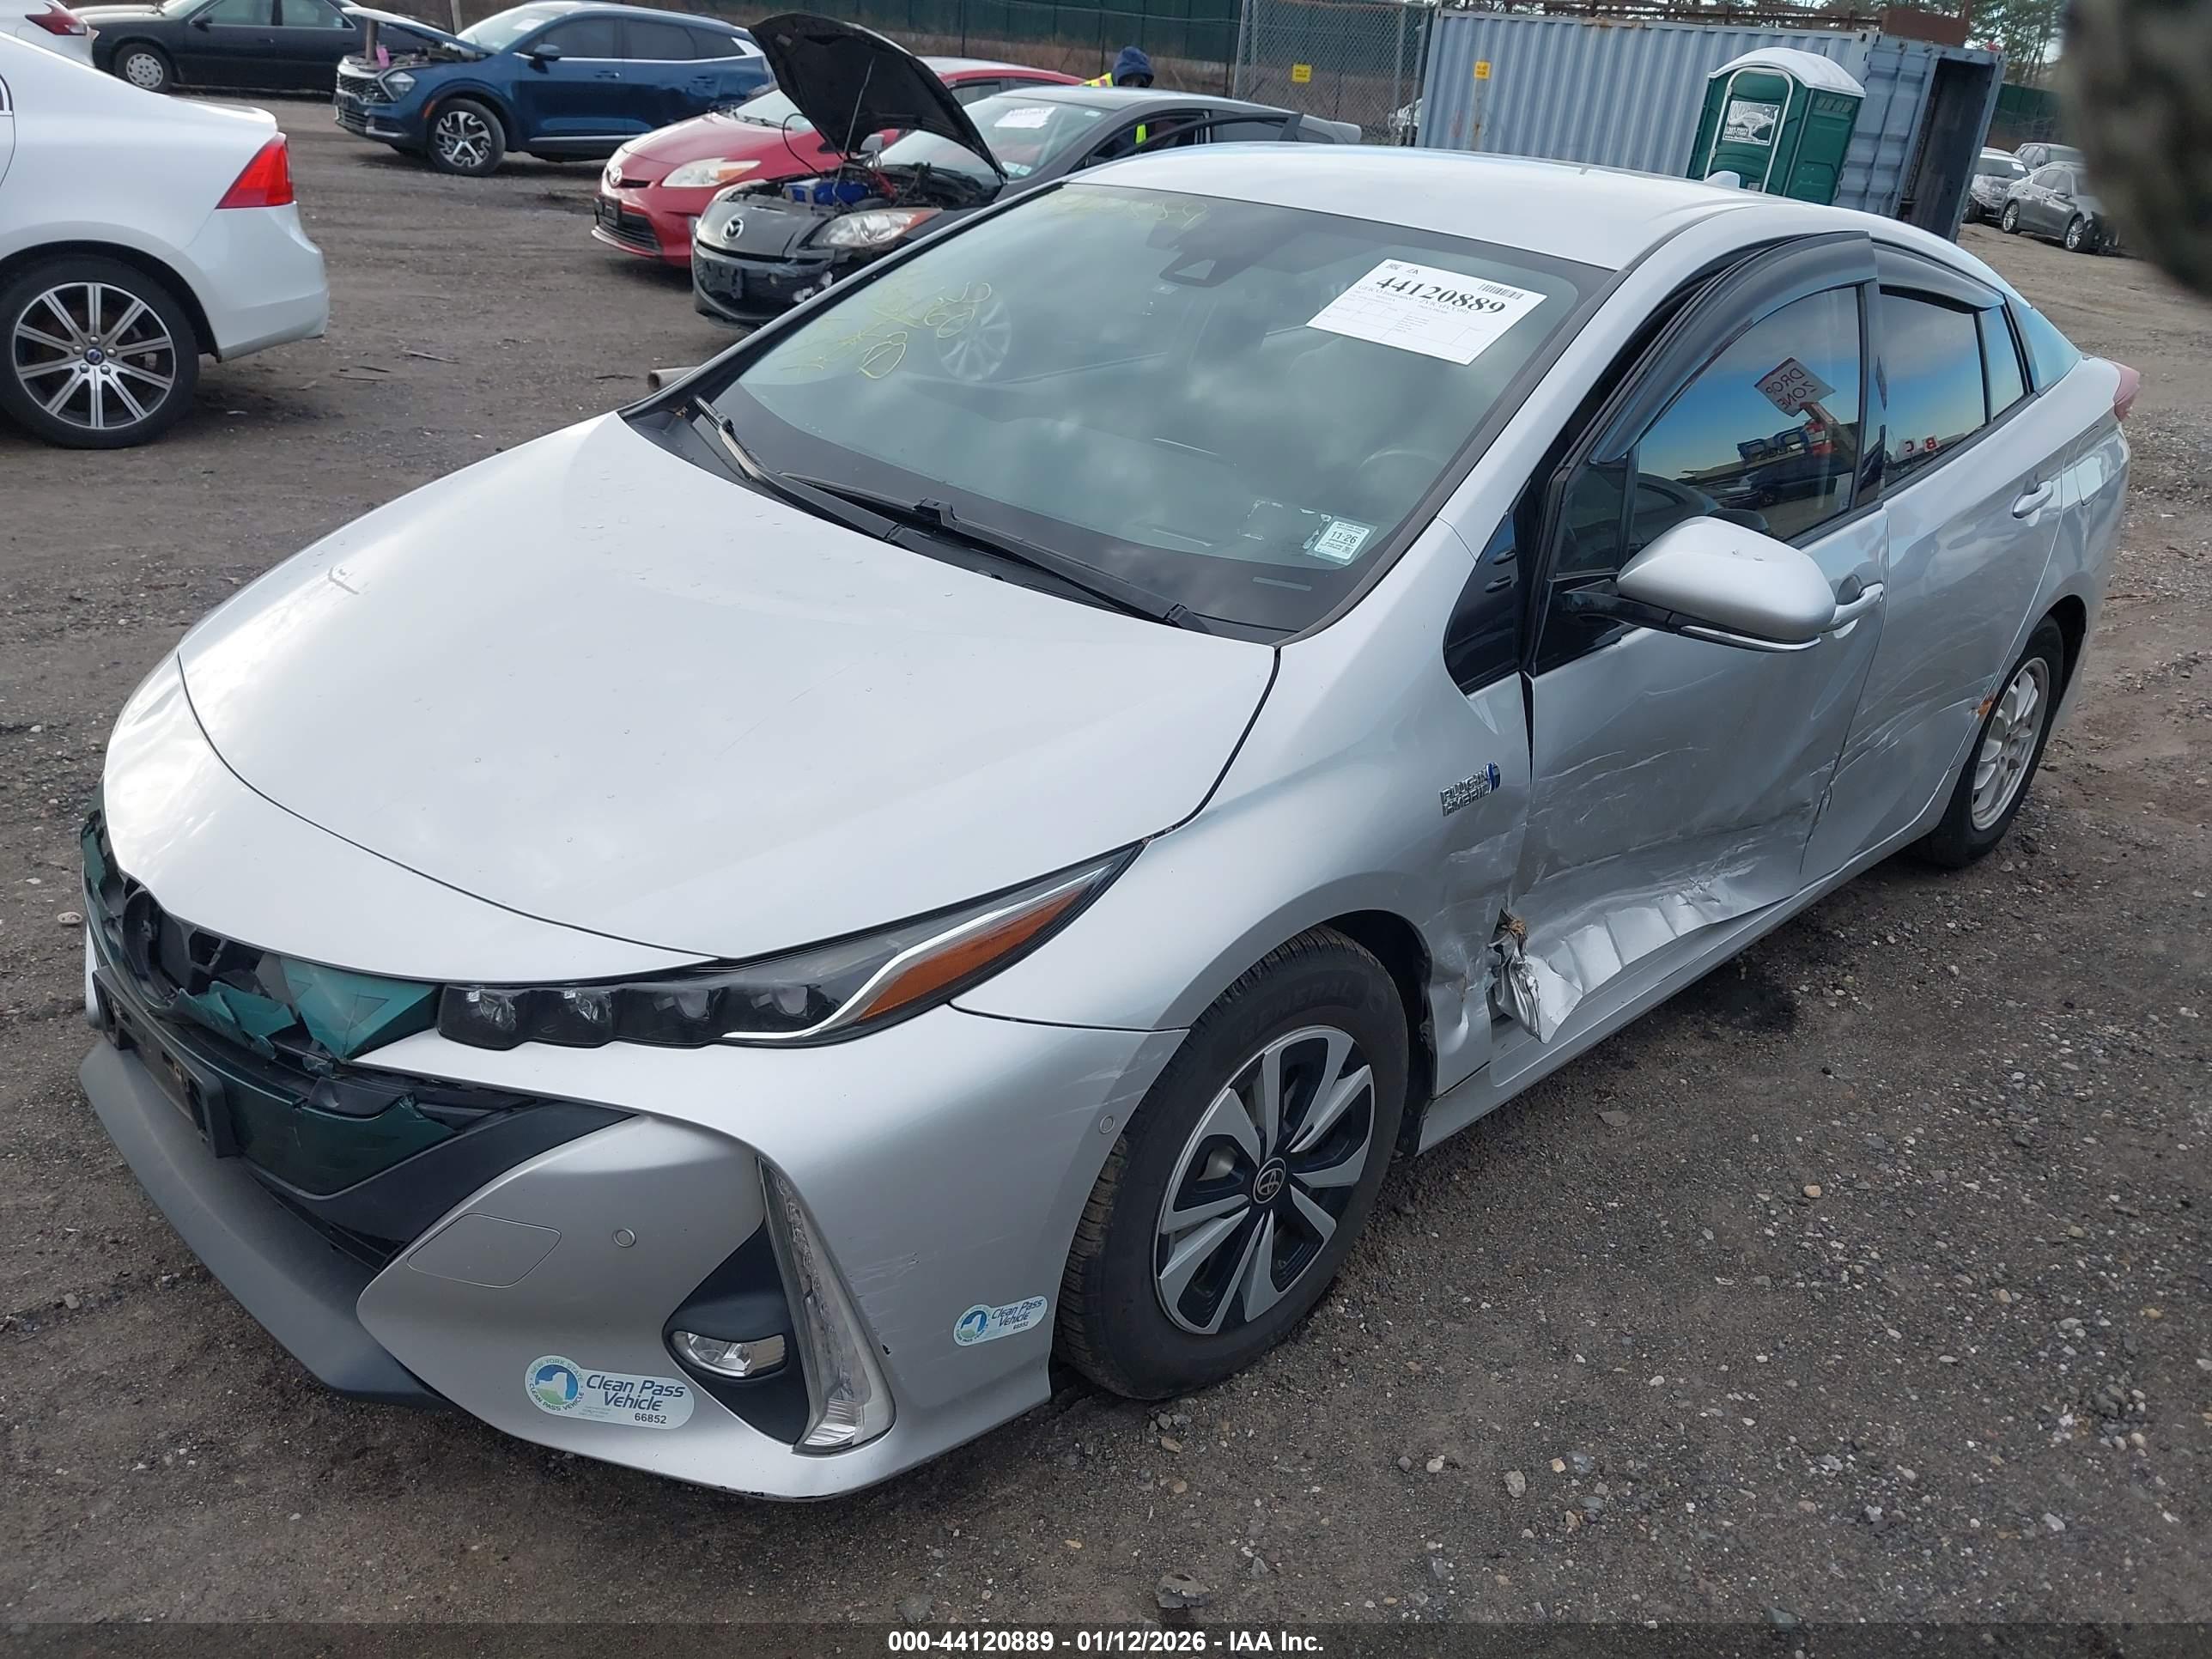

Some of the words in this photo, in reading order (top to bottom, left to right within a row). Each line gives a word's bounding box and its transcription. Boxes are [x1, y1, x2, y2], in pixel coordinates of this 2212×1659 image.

[1376, 276, 1506, 313] 44120889
[992, 1306, 1018, 1320] Clean
[1018, 1298, 1044, 1315] Pass
[999, 1311, 1030, 1327] Vehicle
[529, 1382, 543, 1402] CLEAN
[543, 1401, 562, 1412] PASS
[563, 1391, 585, 1411] VEHICLE
[586, 1374, 635, 1393] Clean
[639, 1379, 686, 1398] Pass
[605, 1391, 664, 1412] Vehicle
[635, 1413, 667, 1425] 66852
